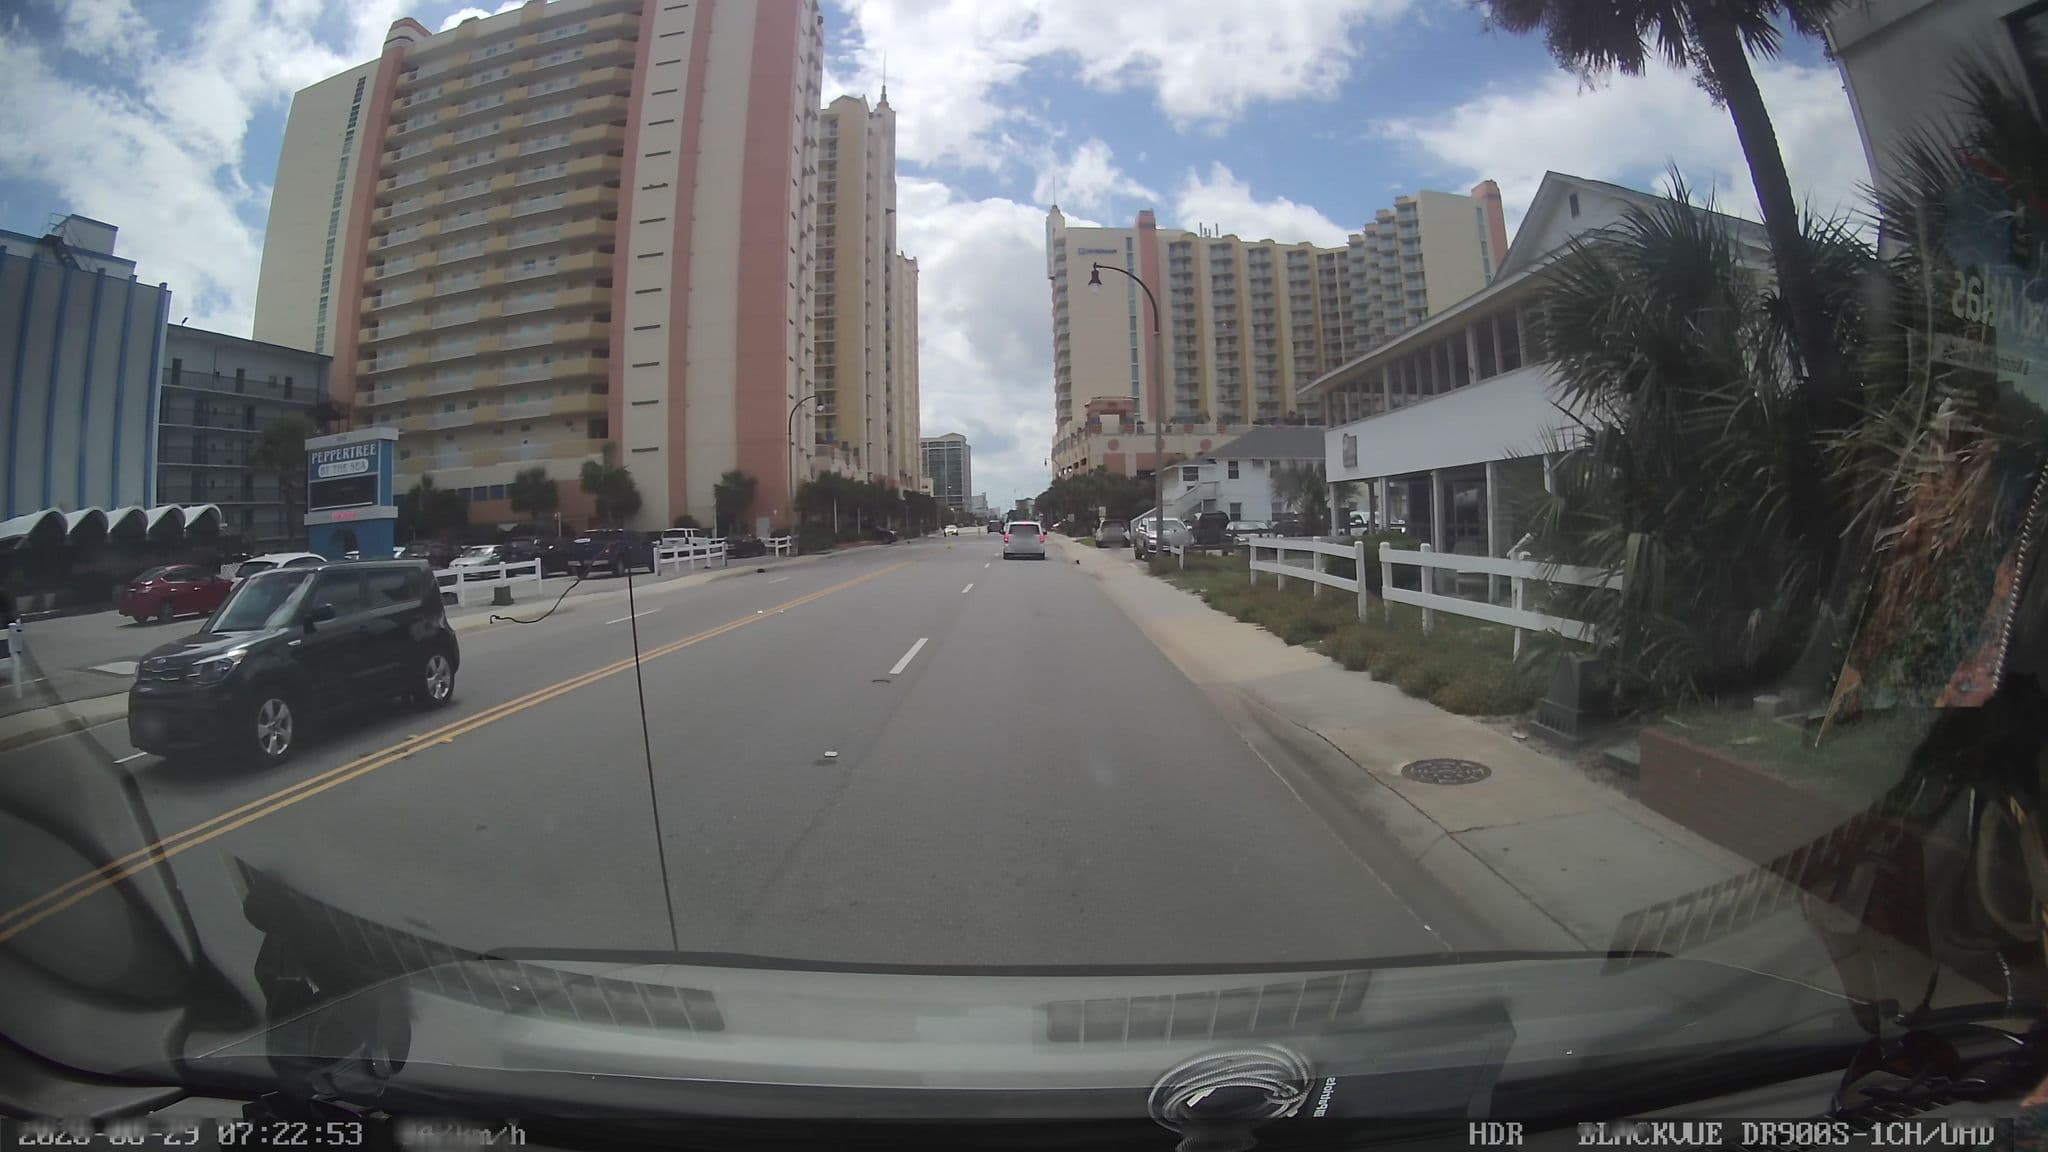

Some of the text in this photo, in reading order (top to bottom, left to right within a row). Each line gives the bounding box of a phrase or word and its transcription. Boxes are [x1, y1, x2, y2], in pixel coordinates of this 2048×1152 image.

[311, 443, 377, 464] PEPPERTREE
[334, 462, 348, 474] THE
[350, 460, 366, 472] SEA
